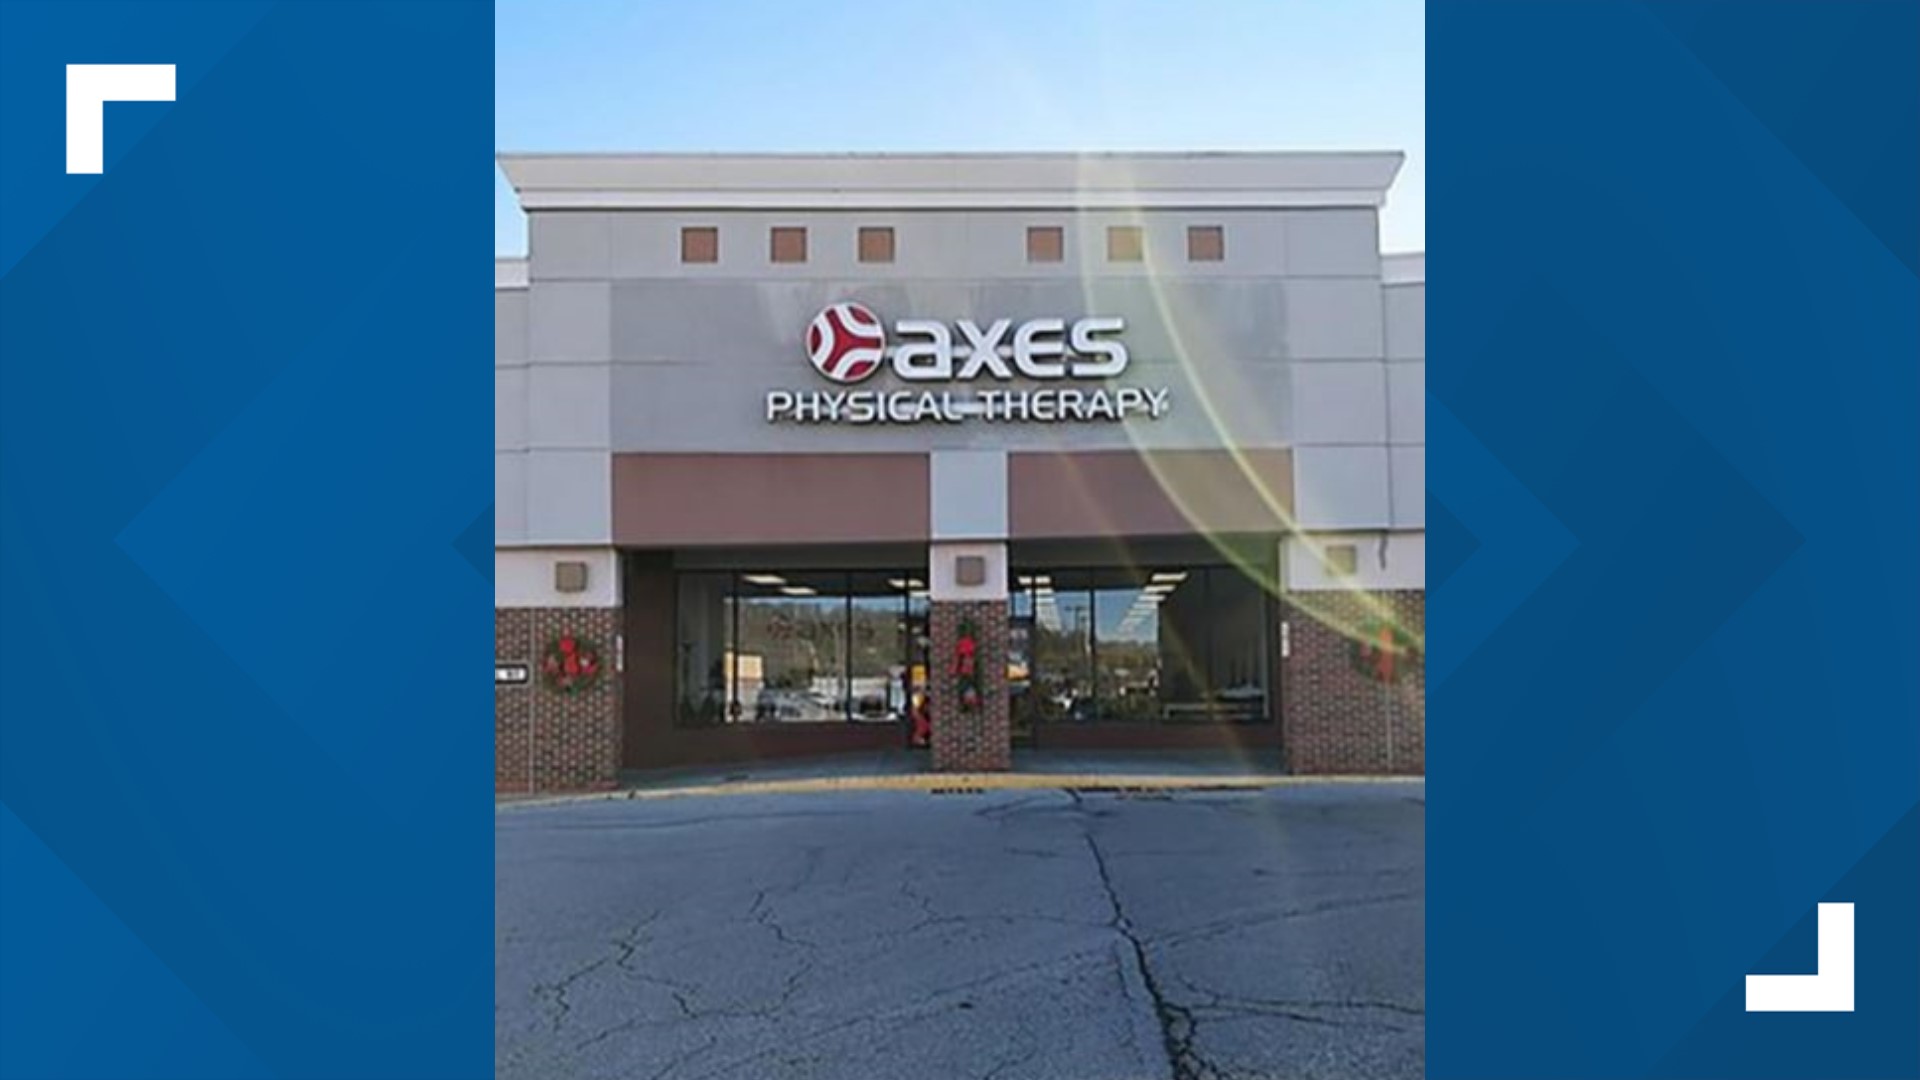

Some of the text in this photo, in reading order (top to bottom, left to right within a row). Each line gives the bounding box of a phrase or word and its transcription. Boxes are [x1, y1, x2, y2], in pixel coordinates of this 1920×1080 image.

[893, 317, 1128, 379] axes
[766, 387, 1169, 423] PHYSICAL THERAPY
